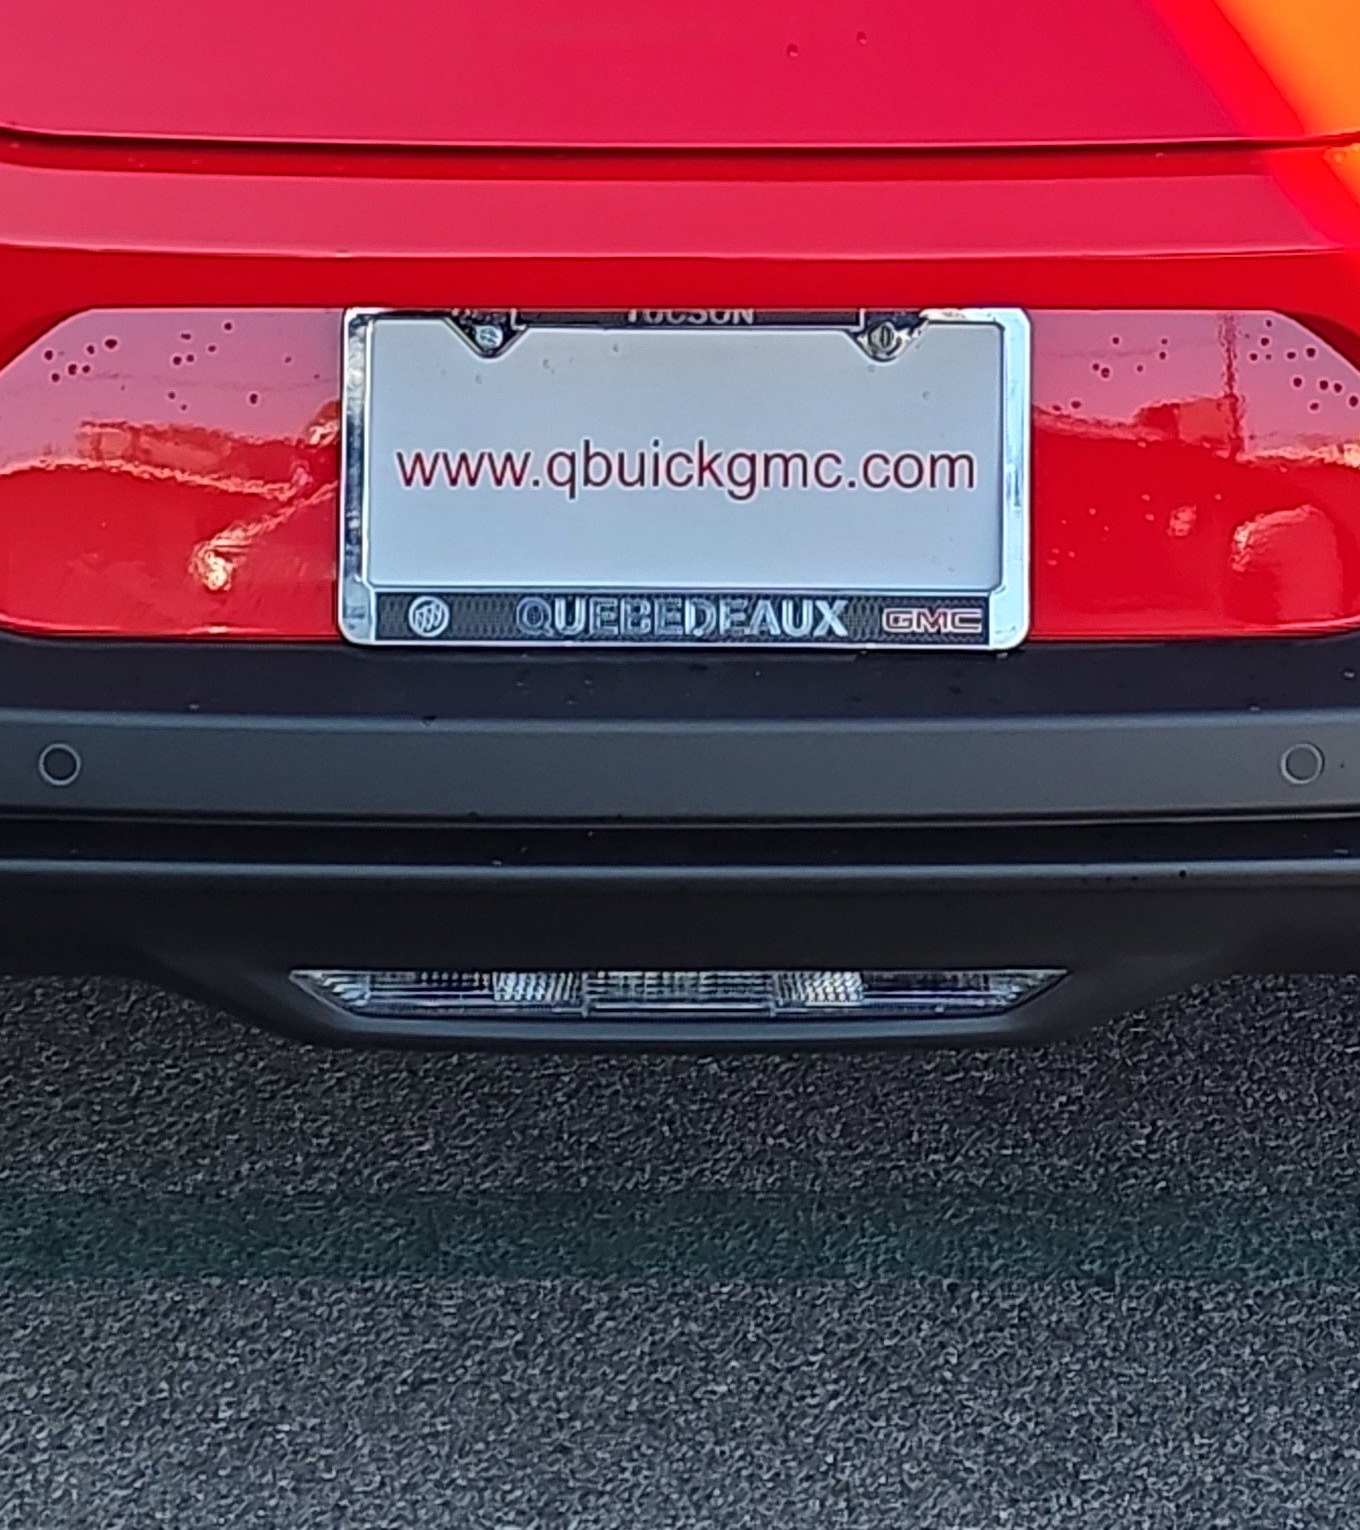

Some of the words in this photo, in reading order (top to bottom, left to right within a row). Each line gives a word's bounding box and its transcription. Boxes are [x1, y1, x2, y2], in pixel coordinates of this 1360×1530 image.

[395, 438, 974, 500] www.qbuickgmc.com
[515, 596, 849, 637] QUEBEDEAUX
[881, 607, 983, 634] GMC
